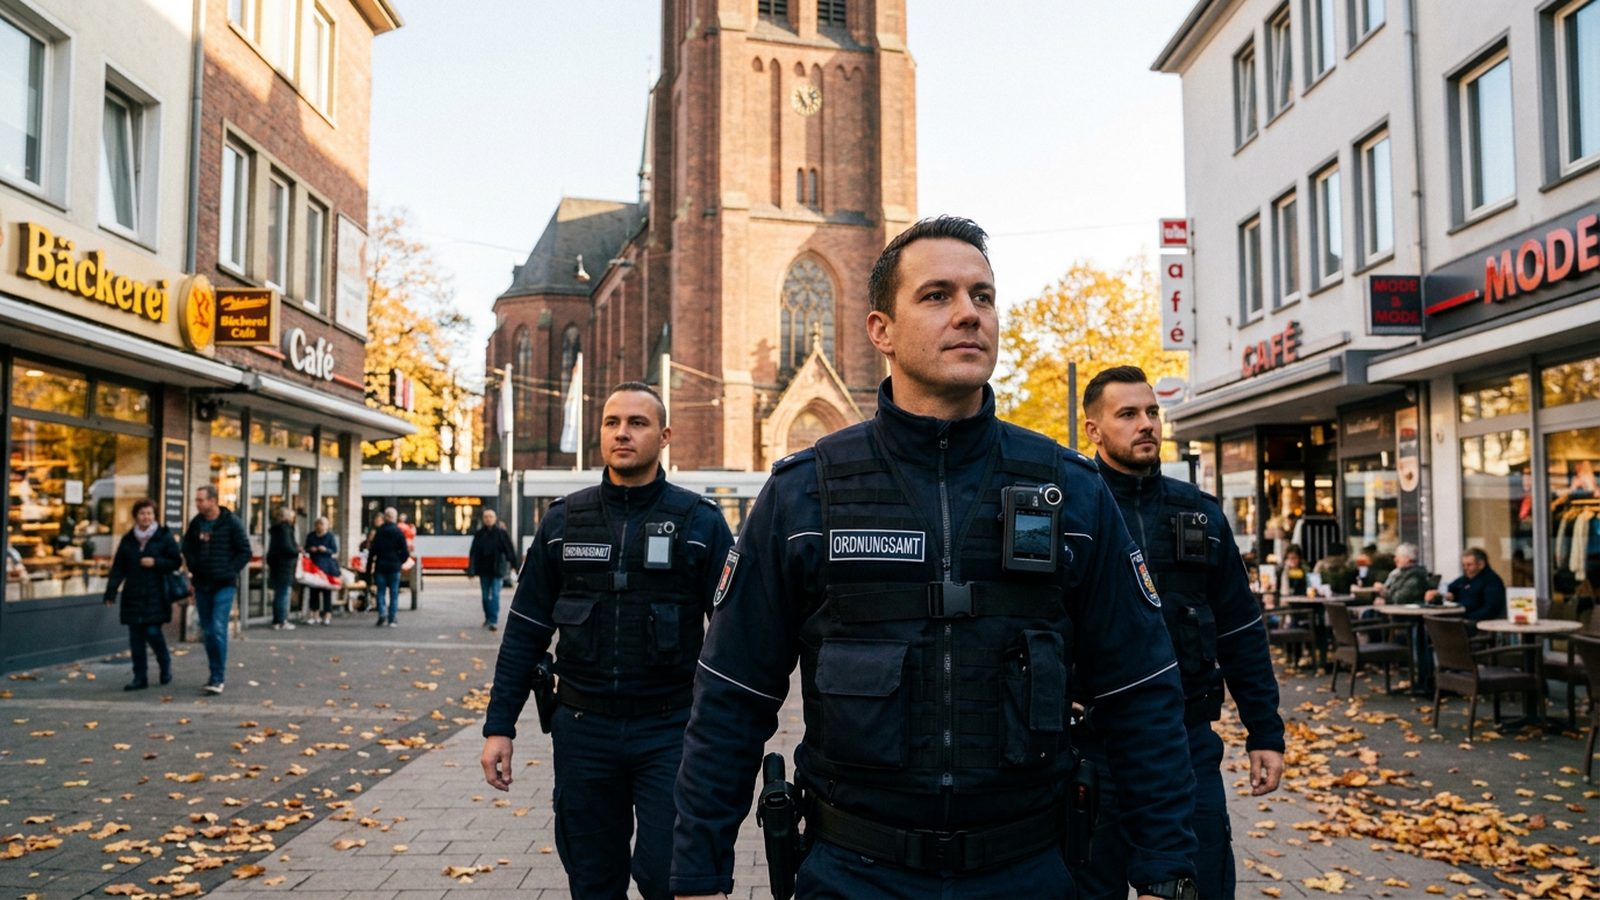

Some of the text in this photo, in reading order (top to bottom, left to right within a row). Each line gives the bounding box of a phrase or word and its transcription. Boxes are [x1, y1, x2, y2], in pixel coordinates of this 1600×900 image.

[26, 223, 170, 323] Bäckerei
[1374, 279, 1418, 292] MODE
[1484, 214, 1600, 305] MODE
[290, 327, 334, 381] Café
[1243, 320, 1297, 377] CAFÉ
[833, 536, 921, 555] ORDNUNGSAMT
